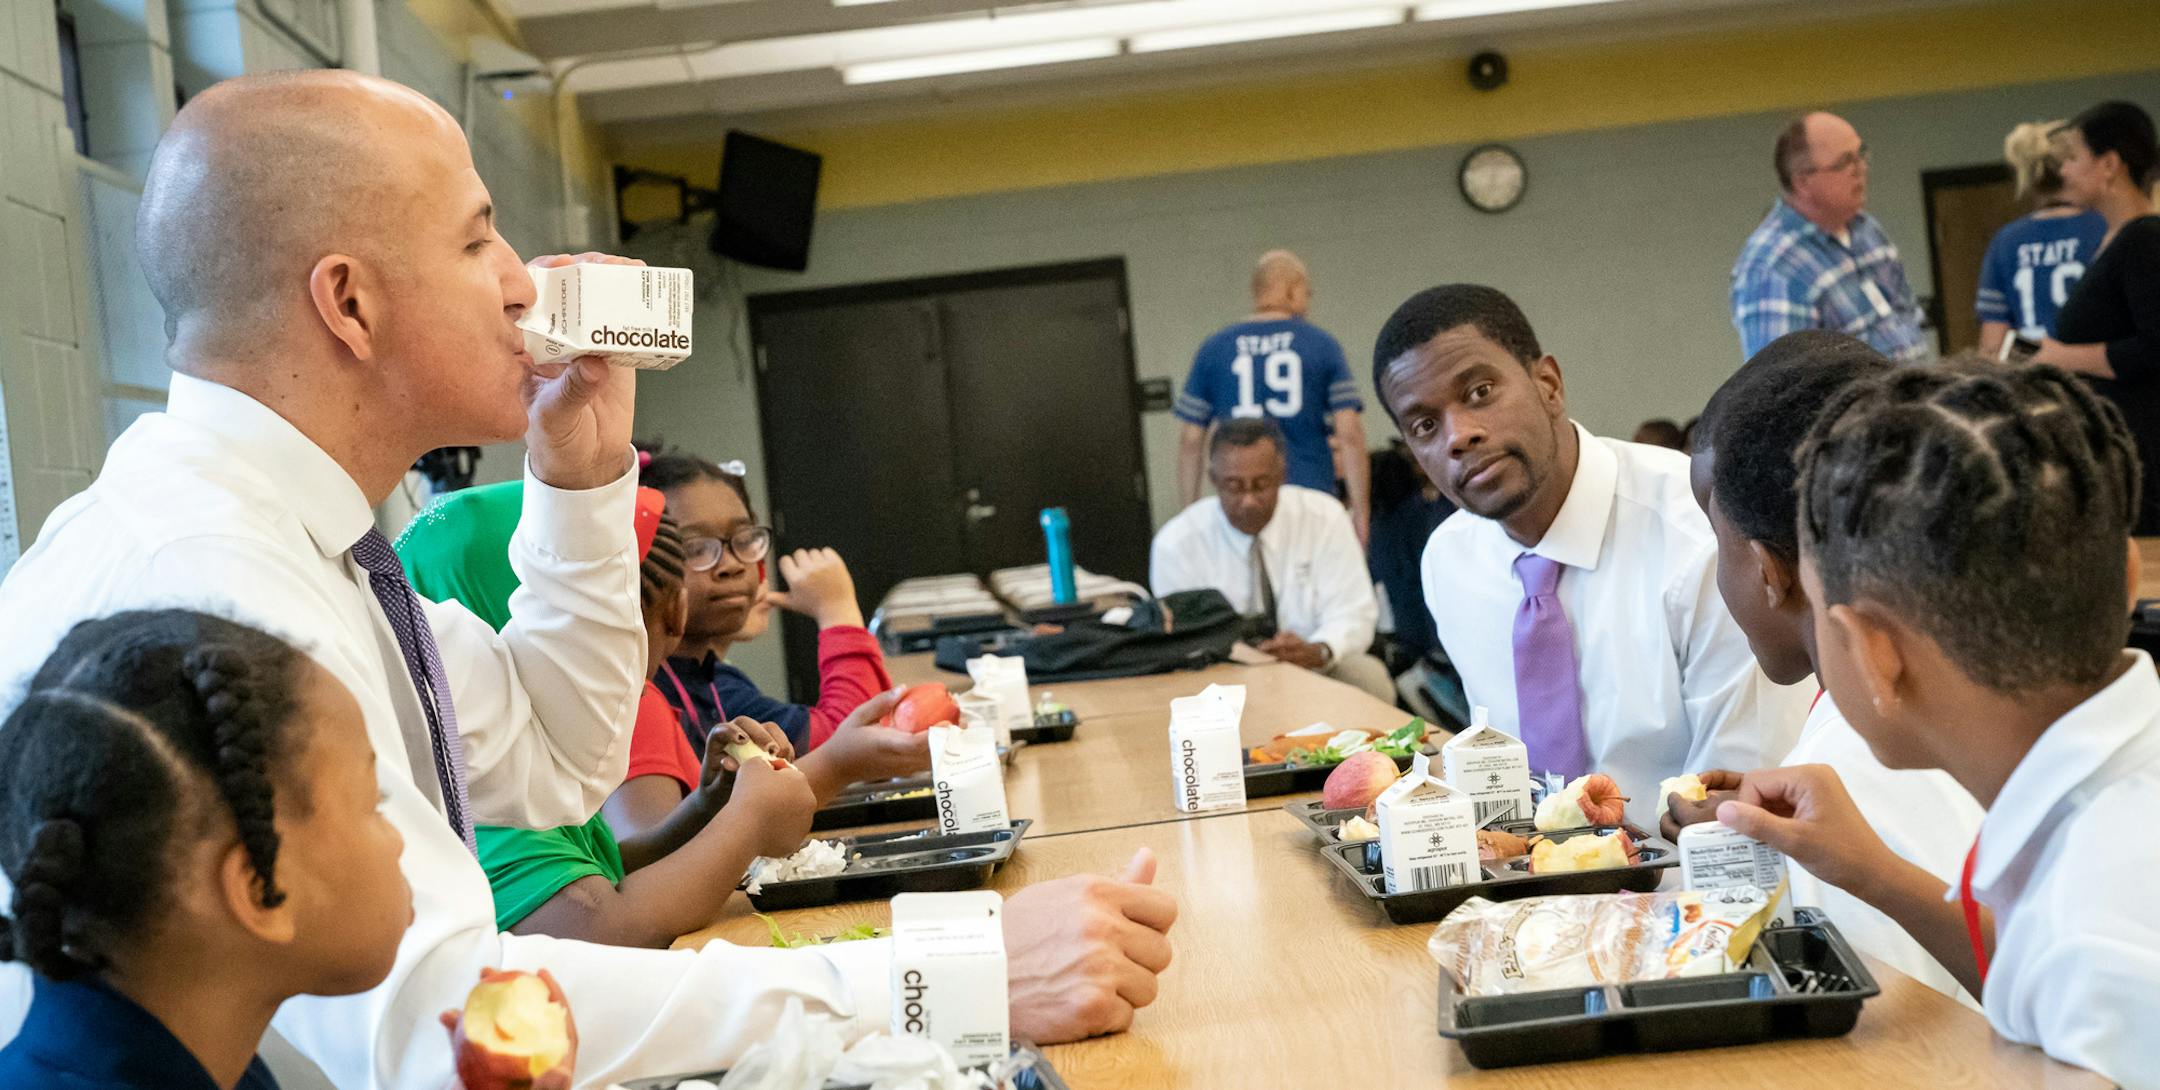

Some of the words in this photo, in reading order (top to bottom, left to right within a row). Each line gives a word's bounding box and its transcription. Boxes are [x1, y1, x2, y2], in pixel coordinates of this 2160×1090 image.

[2017, 238, 2081, 266] STAFF
[591, 325, 689, 349] chocolate
[1236, 331, 1295, 356] STAFF
[1231, 350, 1303, 419] 19
[1182, 739, 1200, 810] chocolate
